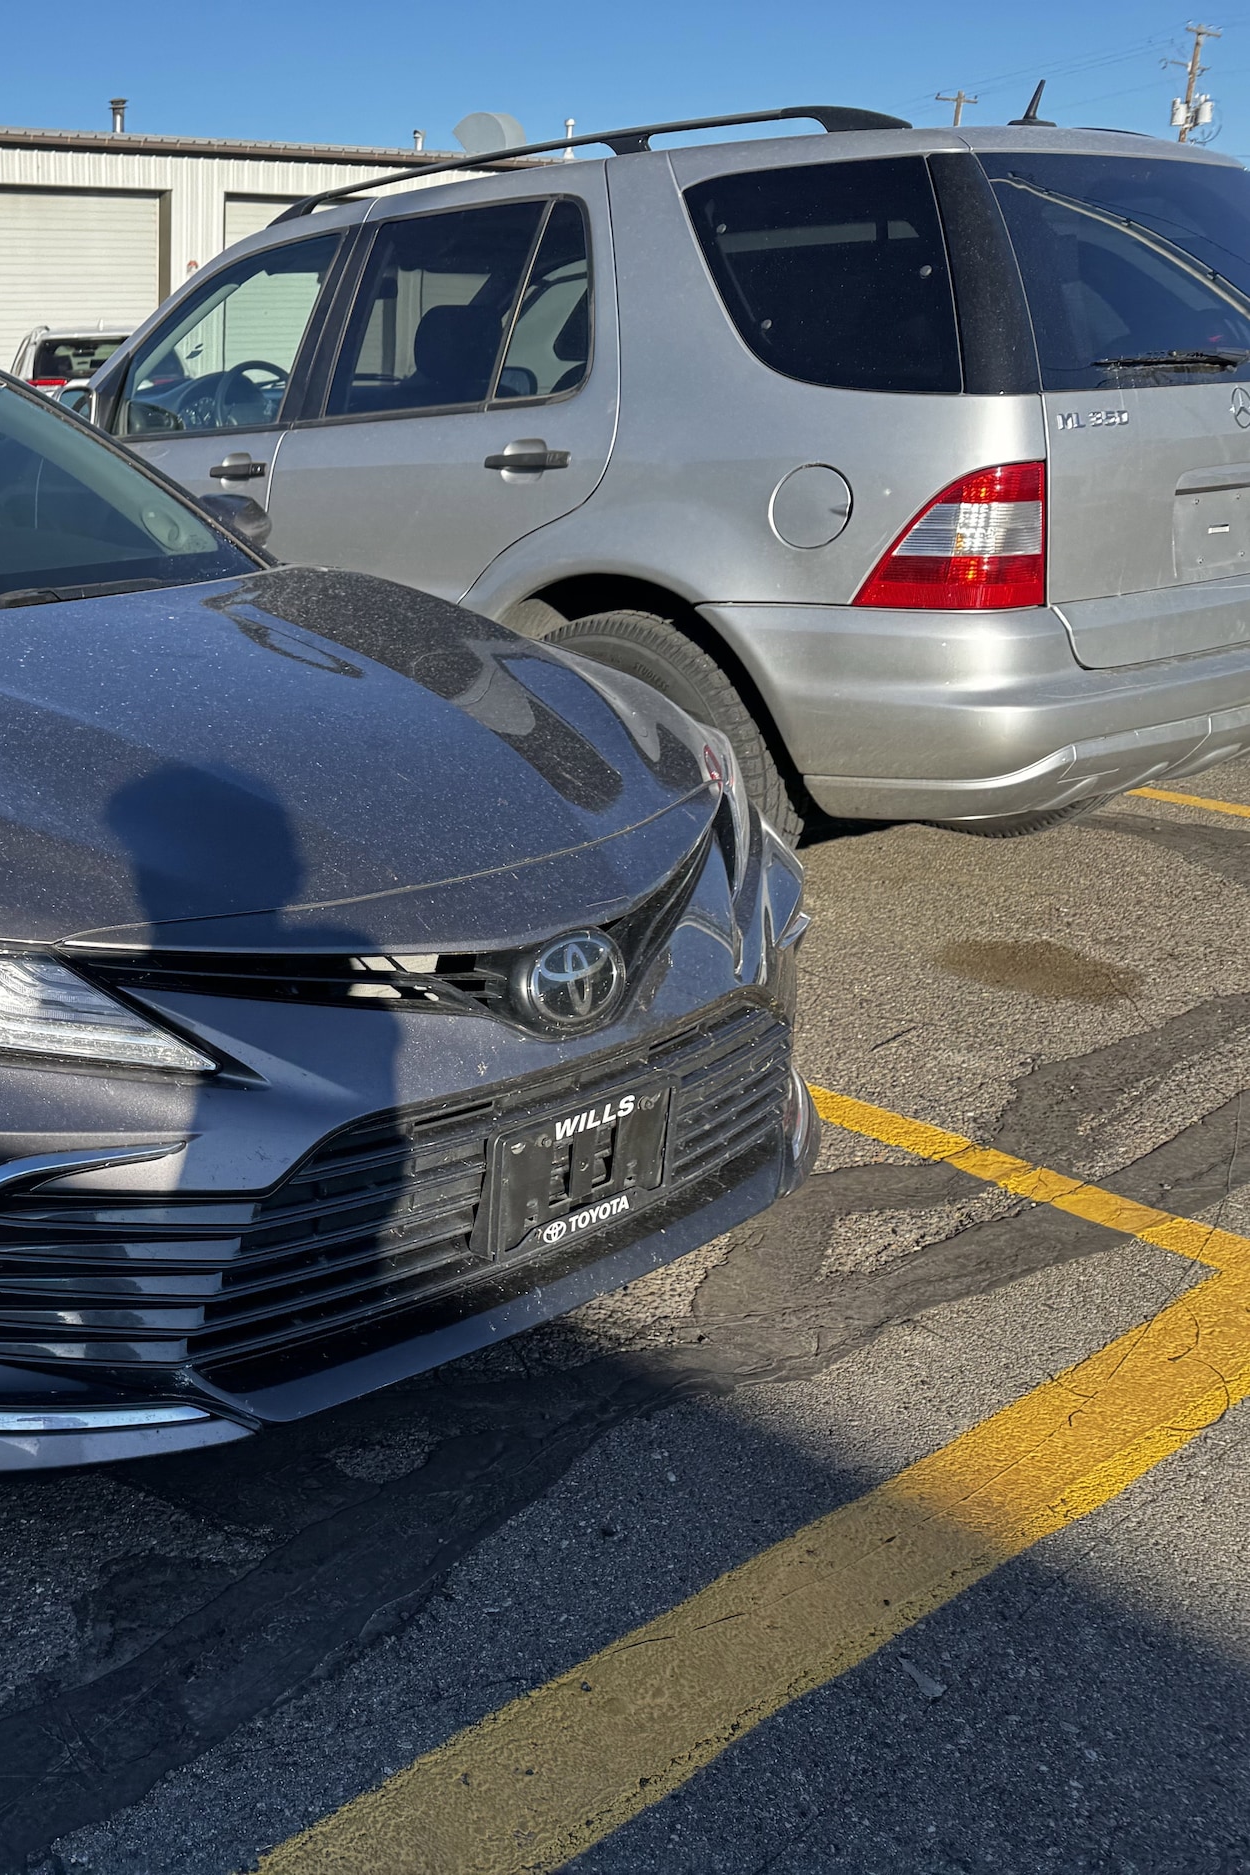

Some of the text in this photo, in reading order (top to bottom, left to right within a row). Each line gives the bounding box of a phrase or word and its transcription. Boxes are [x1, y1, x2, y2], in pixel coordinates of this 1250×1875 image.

[633, 661, 669, 692] STUDLESS
[554, 1094, 635, 1140] WILLS
[568, 1196, 629, 1232] TOYOTA
